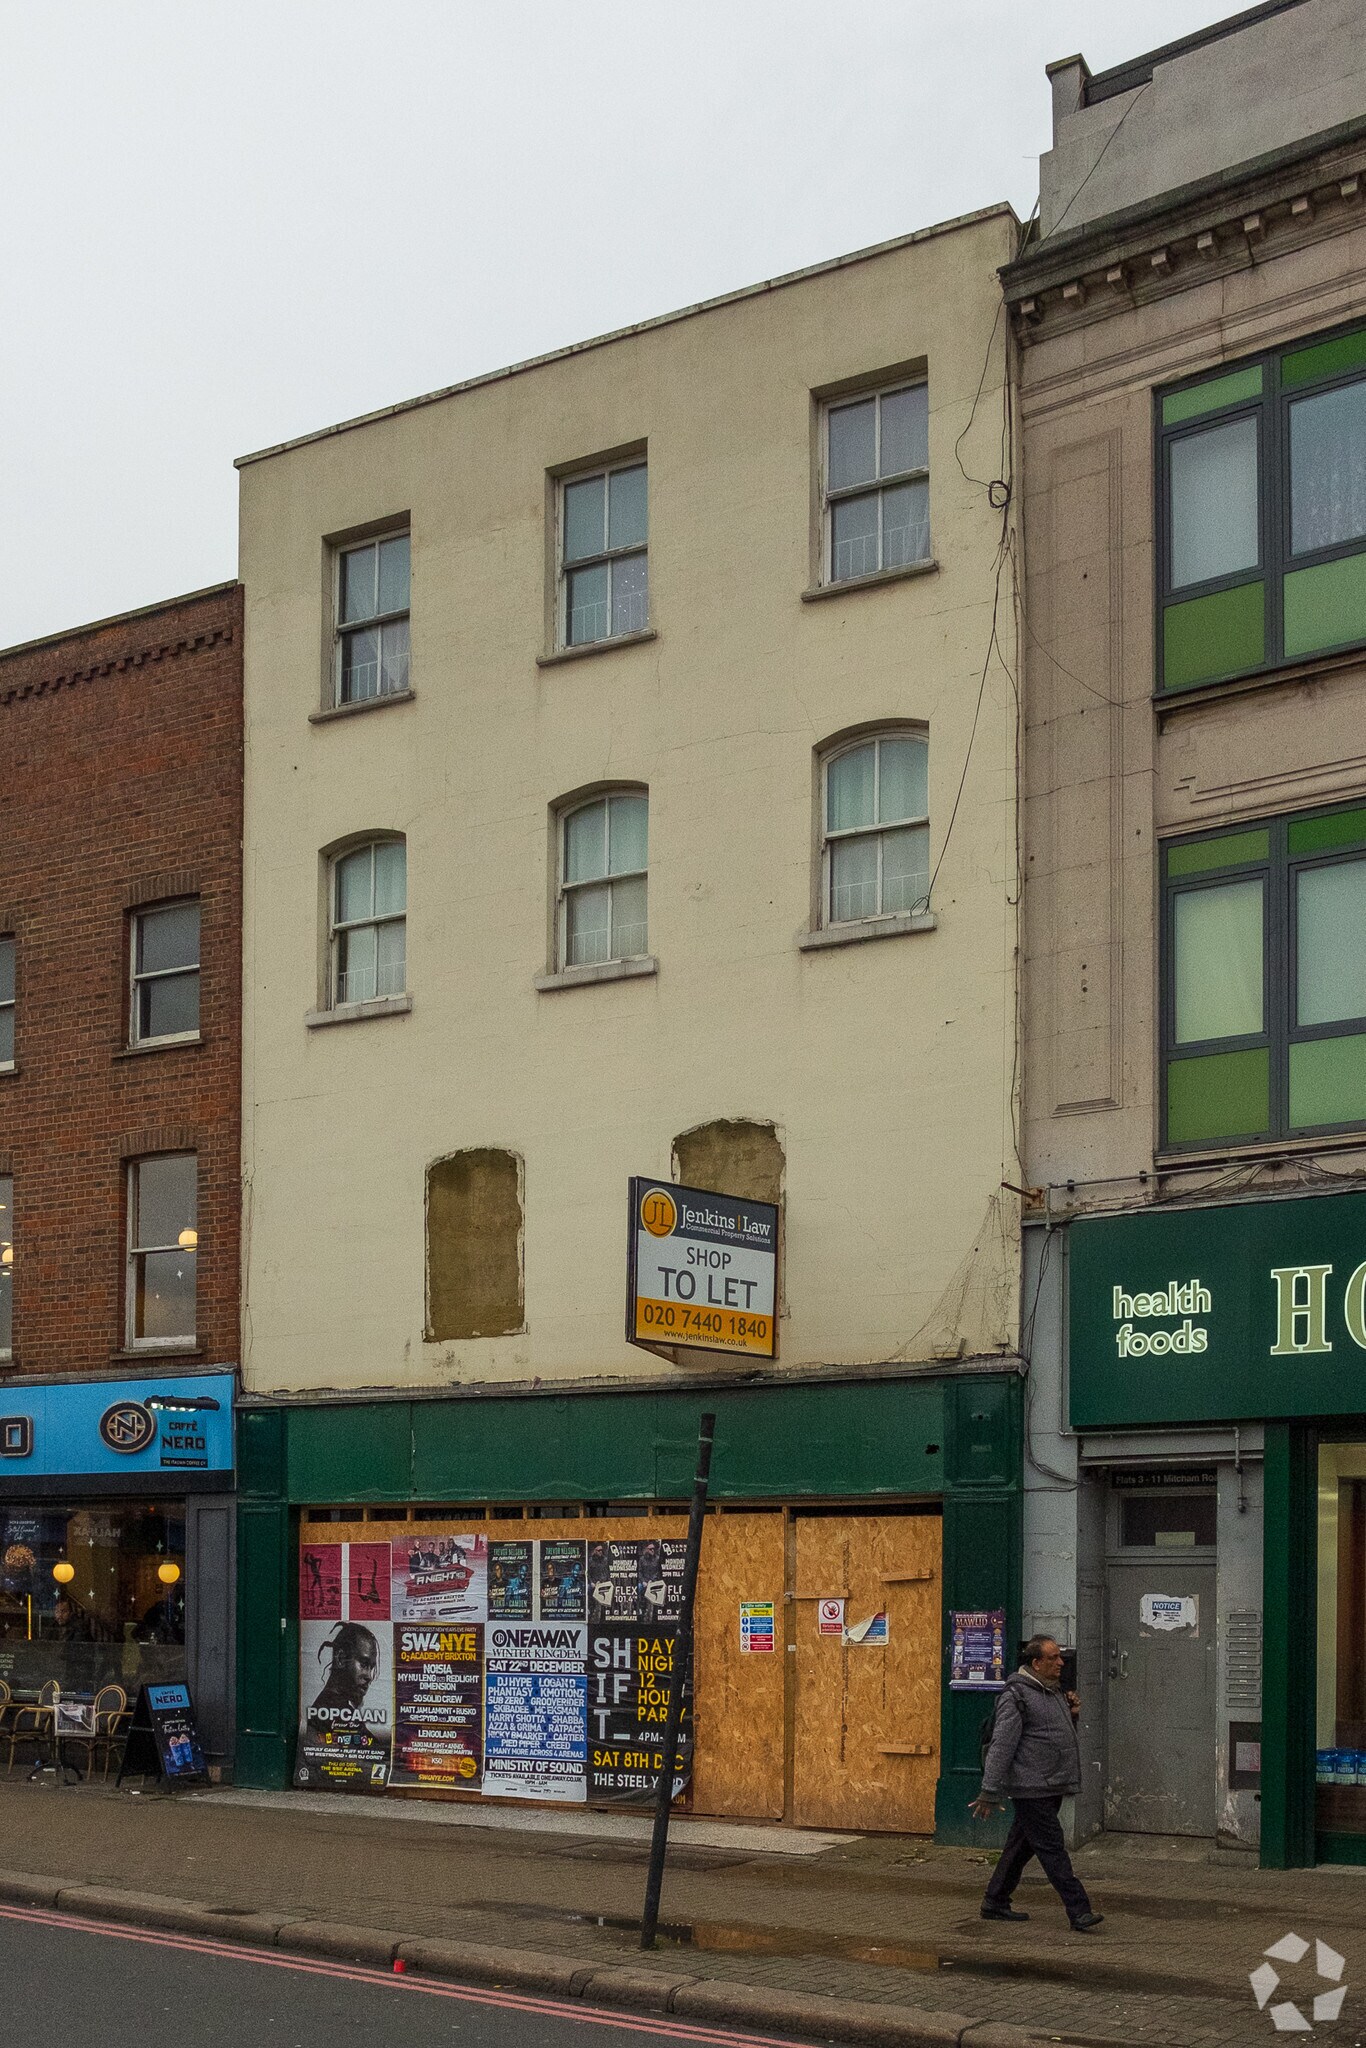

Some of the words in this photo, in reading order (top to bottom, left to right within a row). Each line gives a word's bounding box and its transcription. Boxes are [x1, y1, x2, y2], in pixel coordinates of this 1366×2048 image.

[681, 1204, 736, 1229] Jenkins
[743, 1215, 771, 1237] Law
[686, 1223, 721, 1236] Commercial
[722, 1226, 745, 1241] Property
[746, 1233, 771, 1245] Solutions
[686, 1246, 732, 1270] SHOP
[657, 1266, 696, 1300] TO
[707, 1274, 758, 1309] LET
[1113, 1279, 1212, 1319] health
[644, 1304, 675, 1327] 020
[681, 1309, 722, 1333] 7440
[729, 1316, 767, 1339] 1840
[663, 1330, 748, 1348] www.jenkinslaw.co.uk
[1116, 1319, 1208, 1358] foods
[161, 1435, 206, 1449] NERO
[1116, 1476, 1136, 1484] Flats
[1138, 1475, 1144, 1484] 3
[1163, 1474, 1200, 1484] Mitcham
[425, 1571, 457, 1584] NIGHT
[615, 1586, 638, 1596] FLEX
[1153, 1602, 1181, 1610] NOTICE
[401, 1632, 477, 1652] SW4NYE
[410, 1652, 445, 1661] ACADEMY
[445, 1652, 476, 1661] BRIXTON
[492, 1648, 532, 1658] WINTER
[594, 1638, 631, 1669] SH
[423, 1663, 453, 1674] NOISIA
[489, 1660, 508, 1671] SAT
[508, 1660, 529, 1672] 22ND
[529, 1660, 585, 1674] DECEMBER
[398, 1673, 409, 1681] MY
[409, 1673, 418, 1681] NU
[418, 1674, 437, 1682] LENG
[446, 1675, 480, 1683] REDLIGHT
[497, 1676, 508, 1687] DJ
[509, 1677, 533, 1687] HYPE
[538, 1677, 569, 1688] LOGAN
[569, 1678, 576, 1688] D
[639, 1672, 655, 1688] 12
[420, 1682, 457, 1691] DIMENSION
[488, 1687, 534, 1697] PHANTASY
[540, 1688, 585, 1698] KMOTIONZ
[596, 1673, 631, 1704] IF
[155, 1694, 183, 1705] NERO
[413, 1694, 422, 1702] SO
[422, 1695, 442, 1703] SOLID
[442, 1695, 463, 1703] CREW
[488, 1697, 504, 1705] SUB
[504, 1697, 525, 1705] ZERO
[530, 1698, 585, 1707] GROOVERIDER
[307, 1707, 386, 1723] POPCAAN
[415, 1706, 428, 1714] JAM
[428, 1707, 453, 1715] LAMONT
[493, 1705, 530, 1714] SKIBADEE
[534, 1706, 546, 1715] MC
[546, 1706, 580, 1716] EKSMAN
[488, 1713, 515, 1722] HARRY
[515, 1714, 546, 1724] SHOTTA
[552, 1715, 585, 1725] SHABBA
[418, 1729, 457, 1739] LENGOLAND
[488, 1722, 509, 1731] AZZA
[509, 1723, 516, 1731] &
[516, 1723, 542, 1732] GRIMA
[548, 1724, 584, 1734] RATPACK
[553, 1733, 585, 1742] CARTIER
[501, 1739, 518, 1748] PIED
[518, 1740, 541, 1749] PIPER
[545, 1741, 571, 1750] CREED
[529, 1749, 553, 1757] ACROSS
[594, 1751, 620, 1767] SAT
[623, 1752, 649, 1769] 8TH
[489, 1759, 535, 1772] MINISTRY
[535, 1760, 549, 1772] OF
[549, 1761, 583, 1774] SOUND
[594, 1773, 614, 1787] THE
[617, 1774, 648, 1789] STEEL
